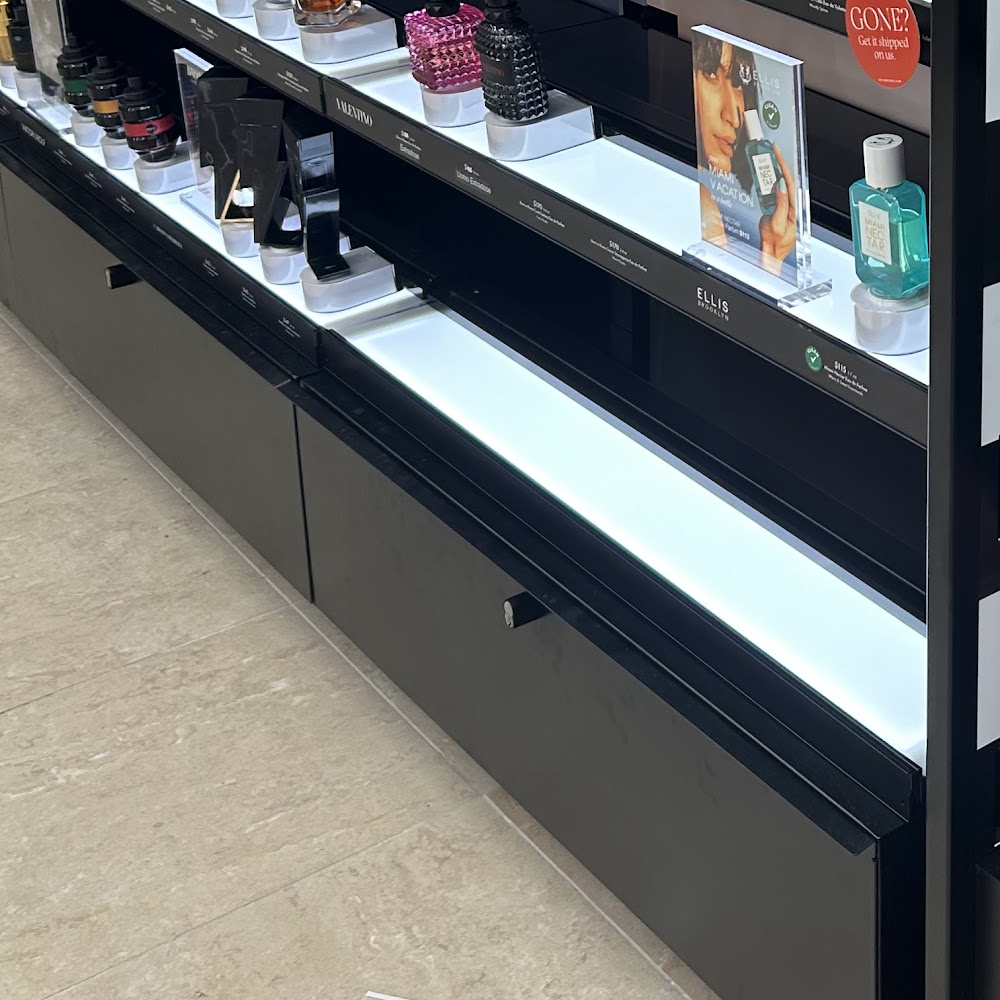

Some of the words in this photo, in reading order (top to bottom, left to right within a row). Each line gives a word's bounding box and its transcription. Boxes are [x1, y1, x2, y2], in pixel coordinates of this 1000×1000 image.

[850, 6, 909, 32] GONE?
[858, 34, 871, 47] Get
[872, 37, 878, 47] it
[878, 36, 910, 50] shipped
[874, 50, 883, 60] on
[883, 51, 896, 61] us.
[753, 70, 780, 88] ELLIS
[336, 97, 373, 127] VALENTINO
[708, 163, 736, 184] MIAMI
[709, 178, 754, 208] VACATION
[866, 225, 885, 241] NEC
[866, 235, 885, 252] TAR
[697, 287, 729, 313] ELLIS
[698, 301, 729, 321] BROOKLYN
[834, 360, 847, 374] $115
